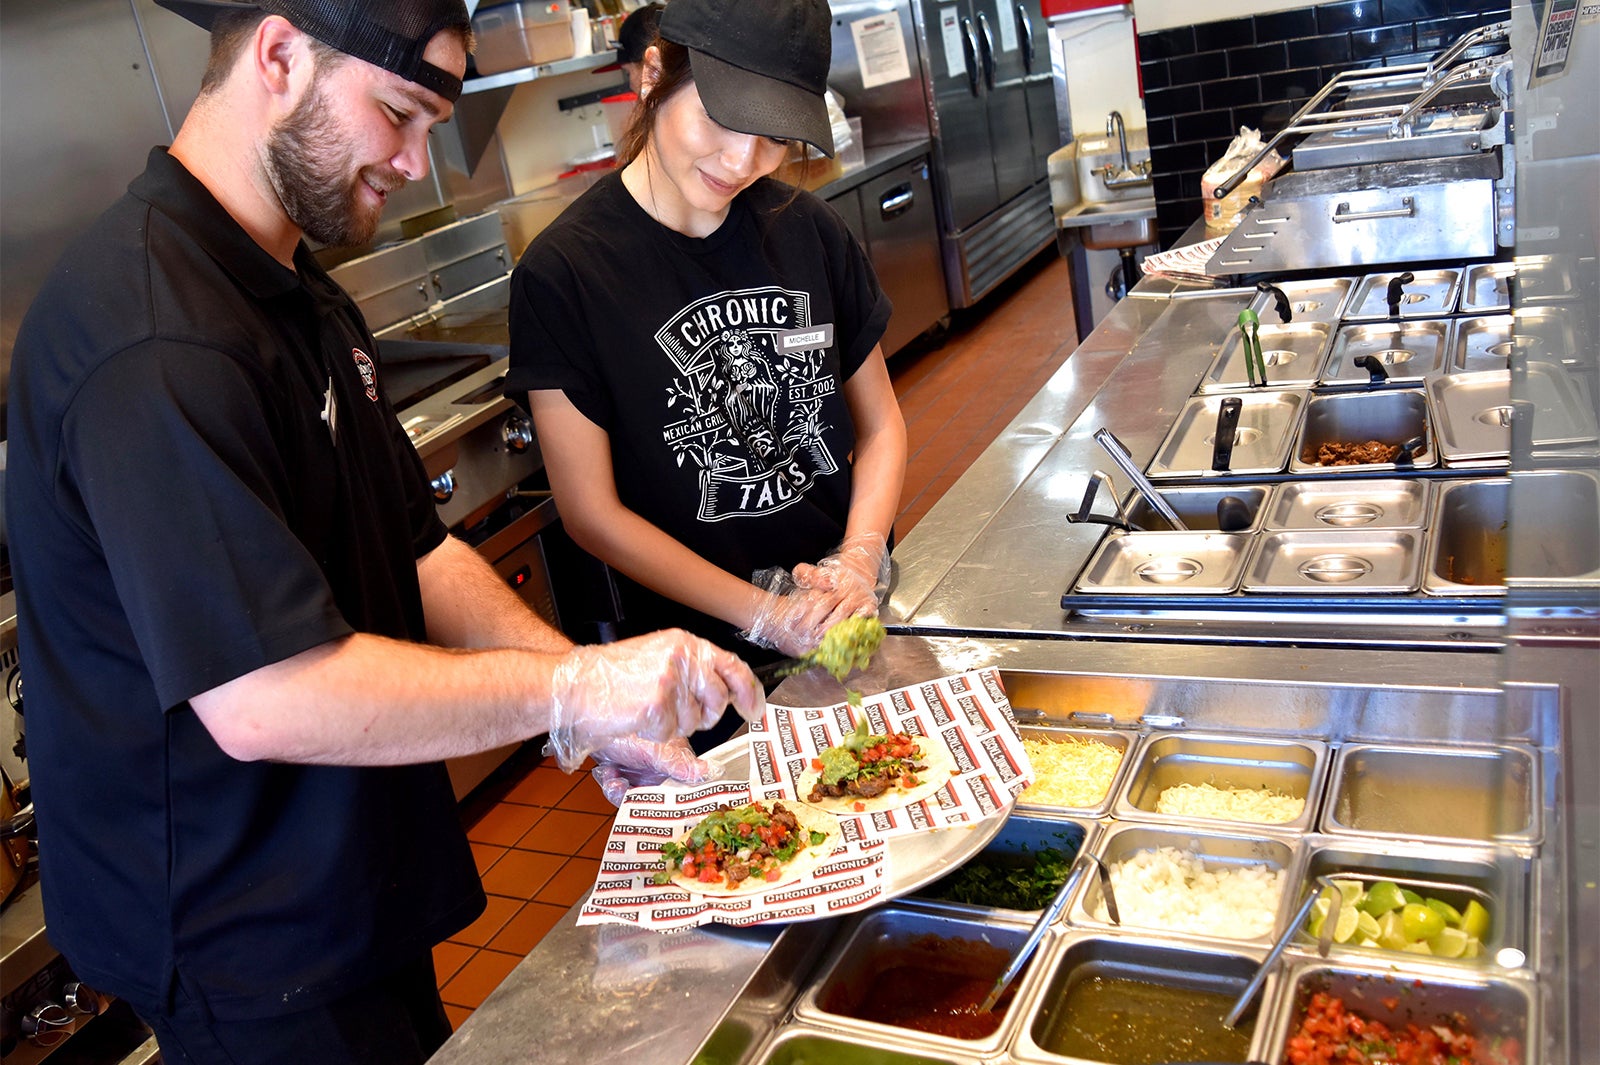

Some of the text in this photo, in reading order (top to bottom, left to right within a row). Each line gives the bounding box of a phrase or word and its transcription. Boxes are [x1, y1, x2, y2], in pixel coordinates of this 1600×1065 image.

[681, 297, 788, 347] CHRONIC
[789, 334, 820, 344] MICHELLE
[789, 378, 835, 400] EST. 2002
[663, 421, 702, 441] MEXICAN
[739, 462, 806, 509] TACS
[780, 725, 798, 756] CHRONIC
[755, 742, 770, 765] TACOS
[629, 793, 664, 802] TACOS
[678, 785, 724, 802] CHRONIC
[632, 802, 717, 818] CHRONIC TACOS
[635, 827, 672, 836] TACOS
[643, 862, 666, 870] TAC
[815, 859, 869, 875] CHRONIC
[766, 877, 863, 903] CHRONIC TACOS
[594, 893, 689, 905] CHRONIC TACOS
[654, 901, 749, 918] CHRONIC TACOS
[714, 906, 813, 926] CHRONIC TACOS
